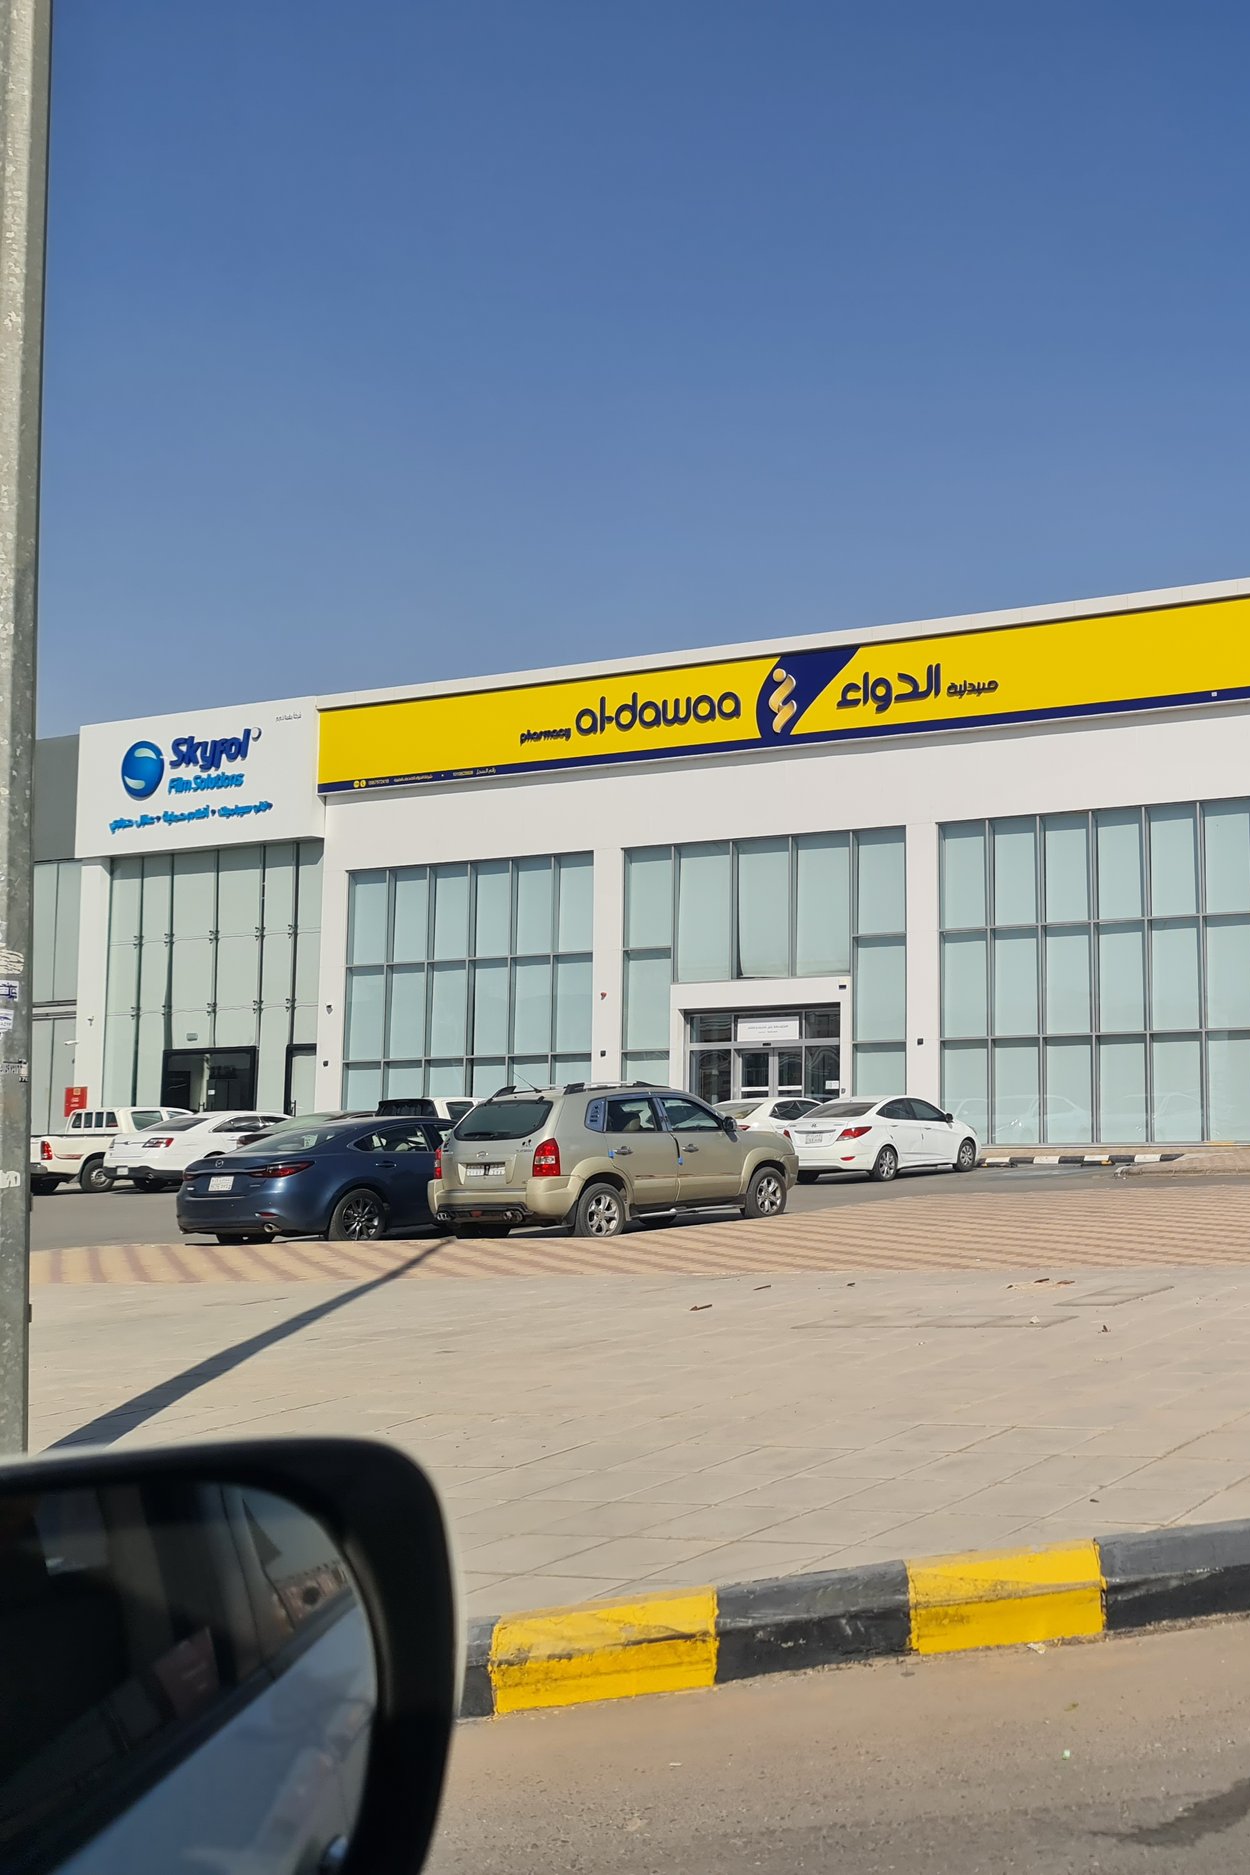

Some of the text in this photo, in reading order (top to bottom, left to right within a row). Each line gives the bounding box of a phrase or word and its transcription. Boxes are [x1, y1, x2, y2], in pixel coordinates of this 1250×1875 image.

[836, 663, 941, 715] الدواء
[519, 691, 741, 746] pharmacy al-dawaa
[168, 772, 245, 795] Film Solutions
